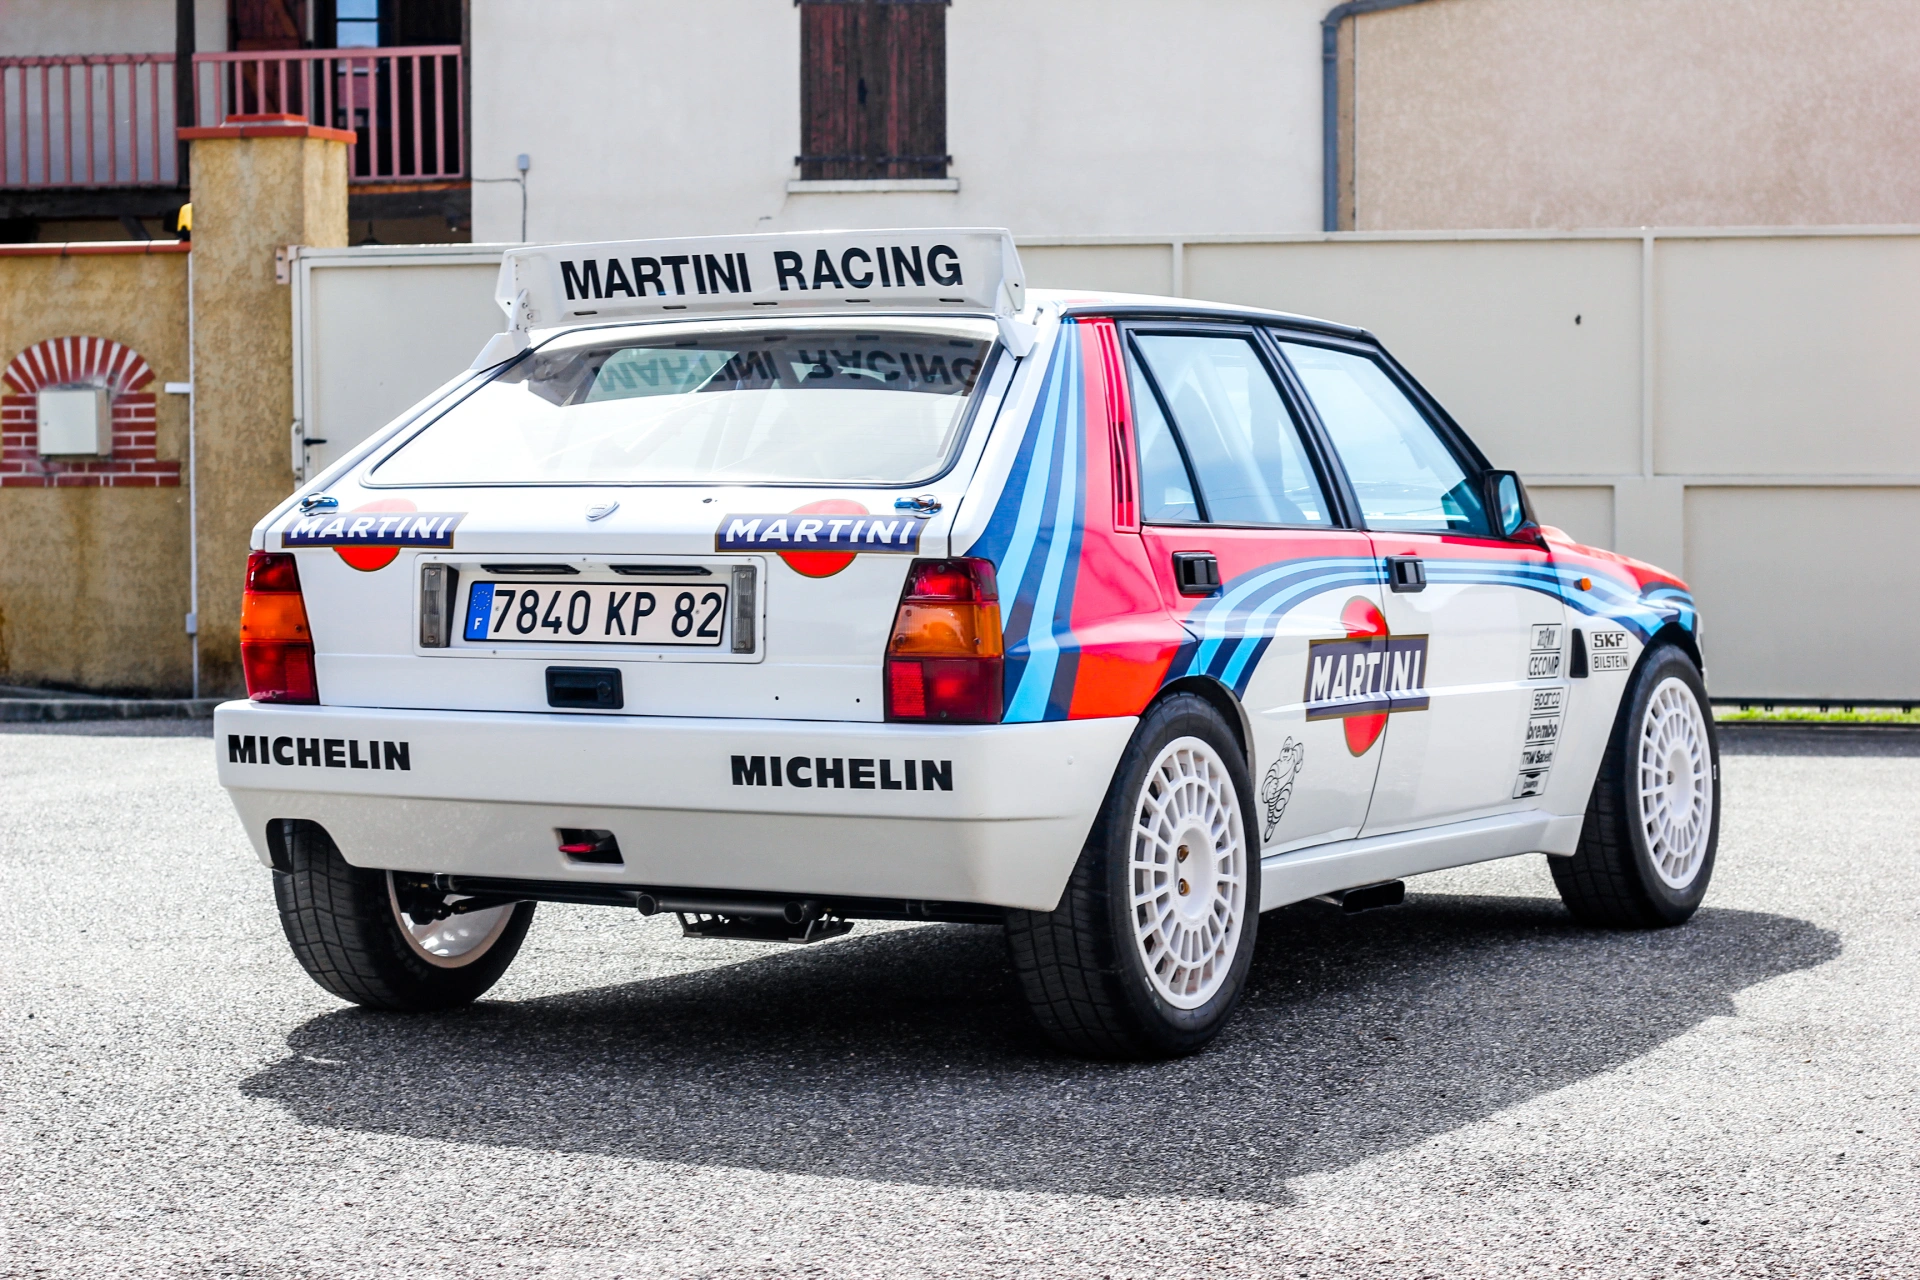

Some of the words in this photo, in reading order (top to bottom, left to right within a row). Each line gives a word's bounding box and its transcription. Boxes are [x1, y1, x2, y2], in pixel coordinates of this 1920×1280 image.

[561, 253, 751, 299] MARTINI
[774, 245, 963, 291] RACING
[290, 517, 454, 539] MARTINI
[725, 519, 915, 544] MARTINI
[474, 617, 483, 630] F
[493, 589, 591, 636] 7840
[604, 591, 656, 636] KP
[671, 592, 722, 638] 82
[1594, 633, 1625, 648] SKF
[1529, 656, 1559, 677] CECOMP
[1594, 654, 1628, 669] BILSTEIN
[1309, 650, 1421, 705] MARTINI
[1534, 692, 1561, 707] sparco
[1527, 720, 1558, 740] brembo
[228, 735, 411, 771] MICHELIN
[730, 755, 953, 791] MICHELIN
